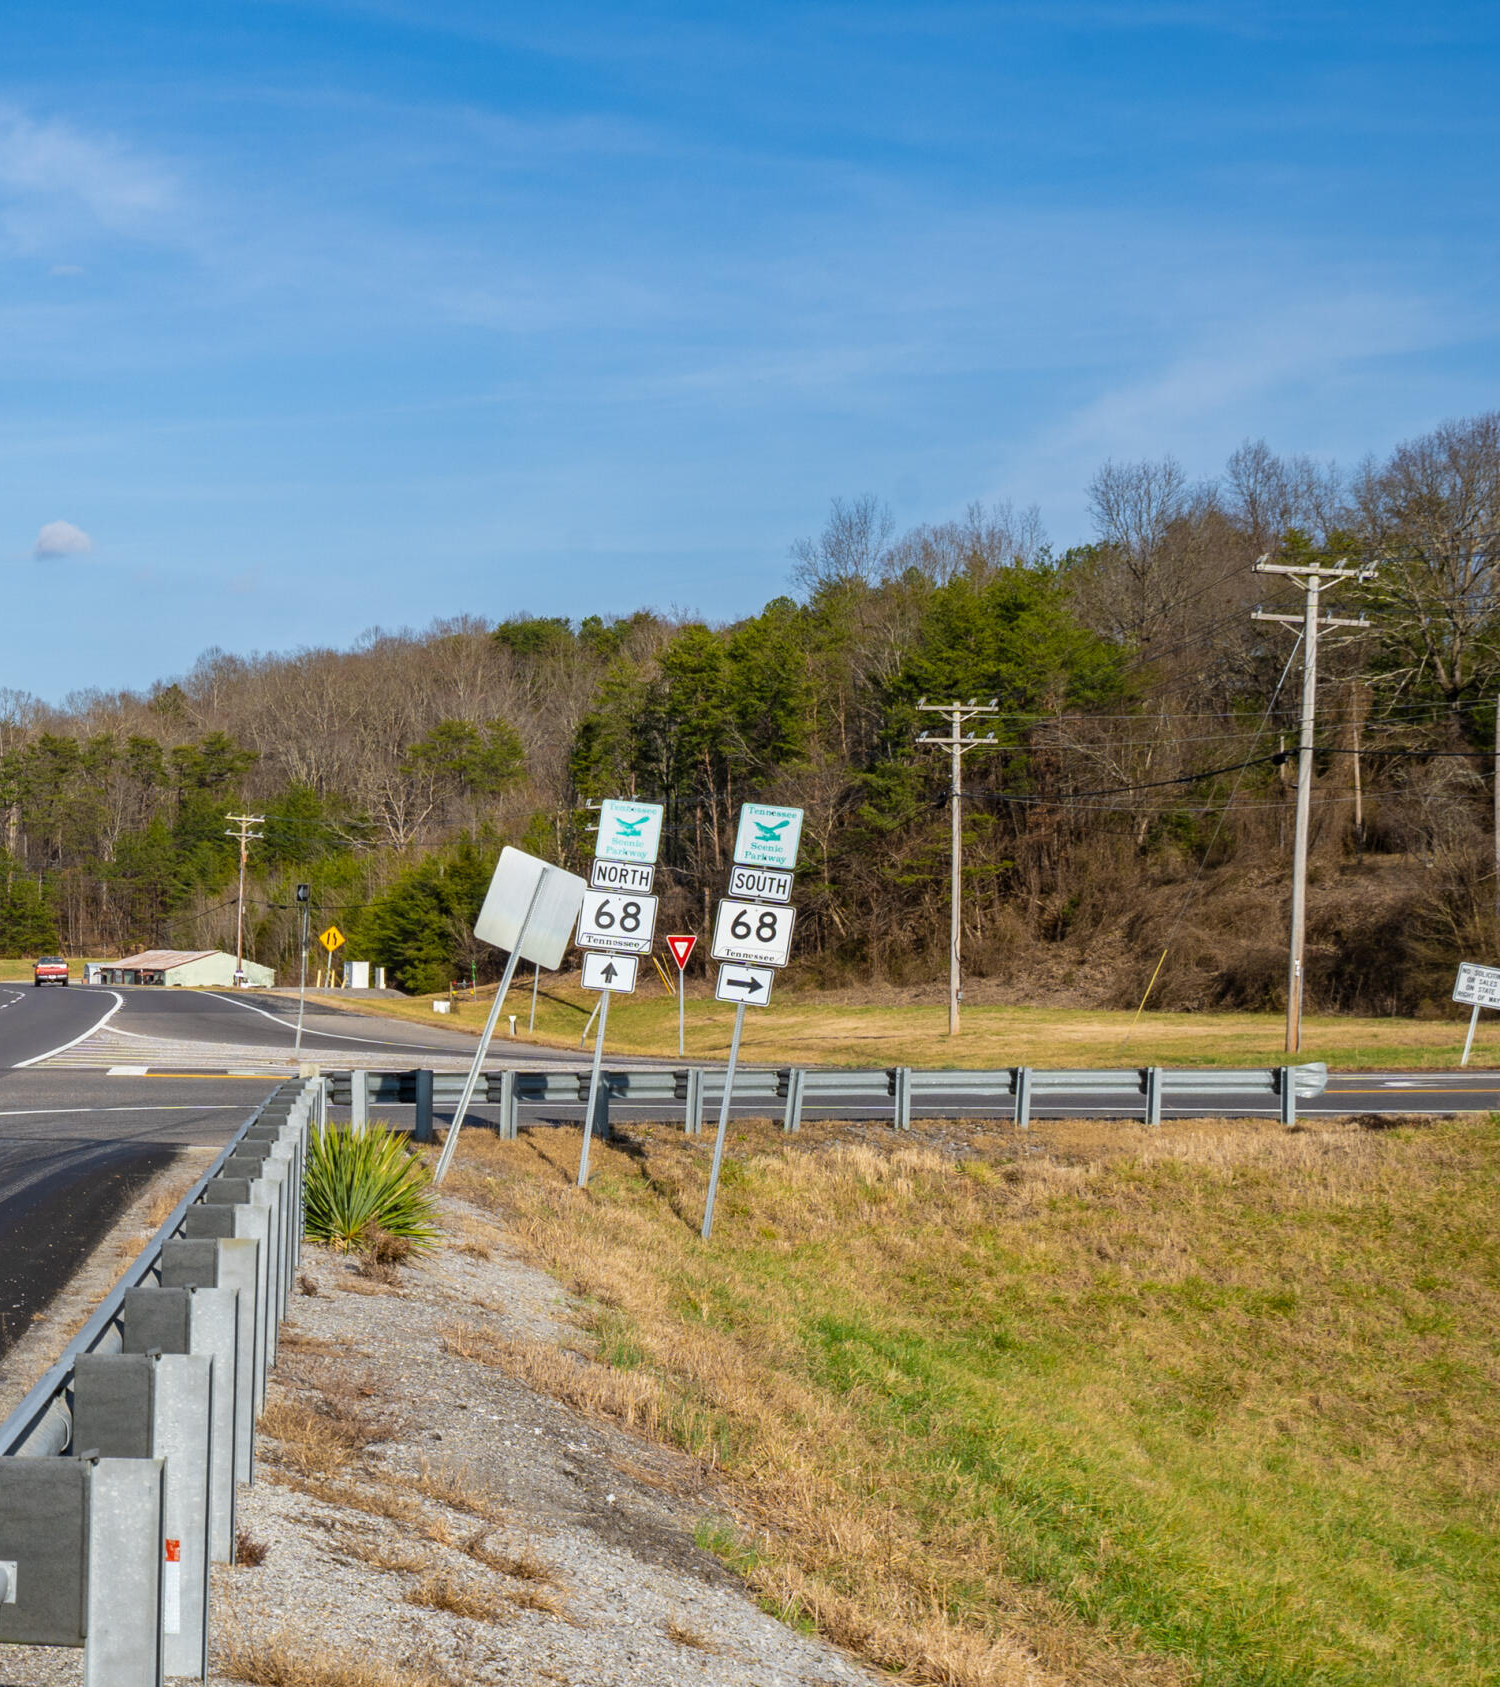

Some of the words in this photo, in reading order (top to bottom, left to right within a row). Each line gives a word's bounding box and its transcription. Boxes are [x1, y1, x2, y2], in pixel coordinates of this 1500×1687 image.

[748, 806, 797, 818] Tennessee
[611, 838, 644, 848] Scenic
[750, 842, 784, 853] Scenic
[605, 846, 647, 858] Parkway
[744, 851, 786, 864] Parkway
[597, 865, 650, 887] NORTH
[735, 873, 787, 895] SOUTH
[595, 899, 641, 933] 68
[731, 909, 777, 943] 68
[586, 935, 640, 948] Tennessee
[725, 948, 775, 961] Tennessee
